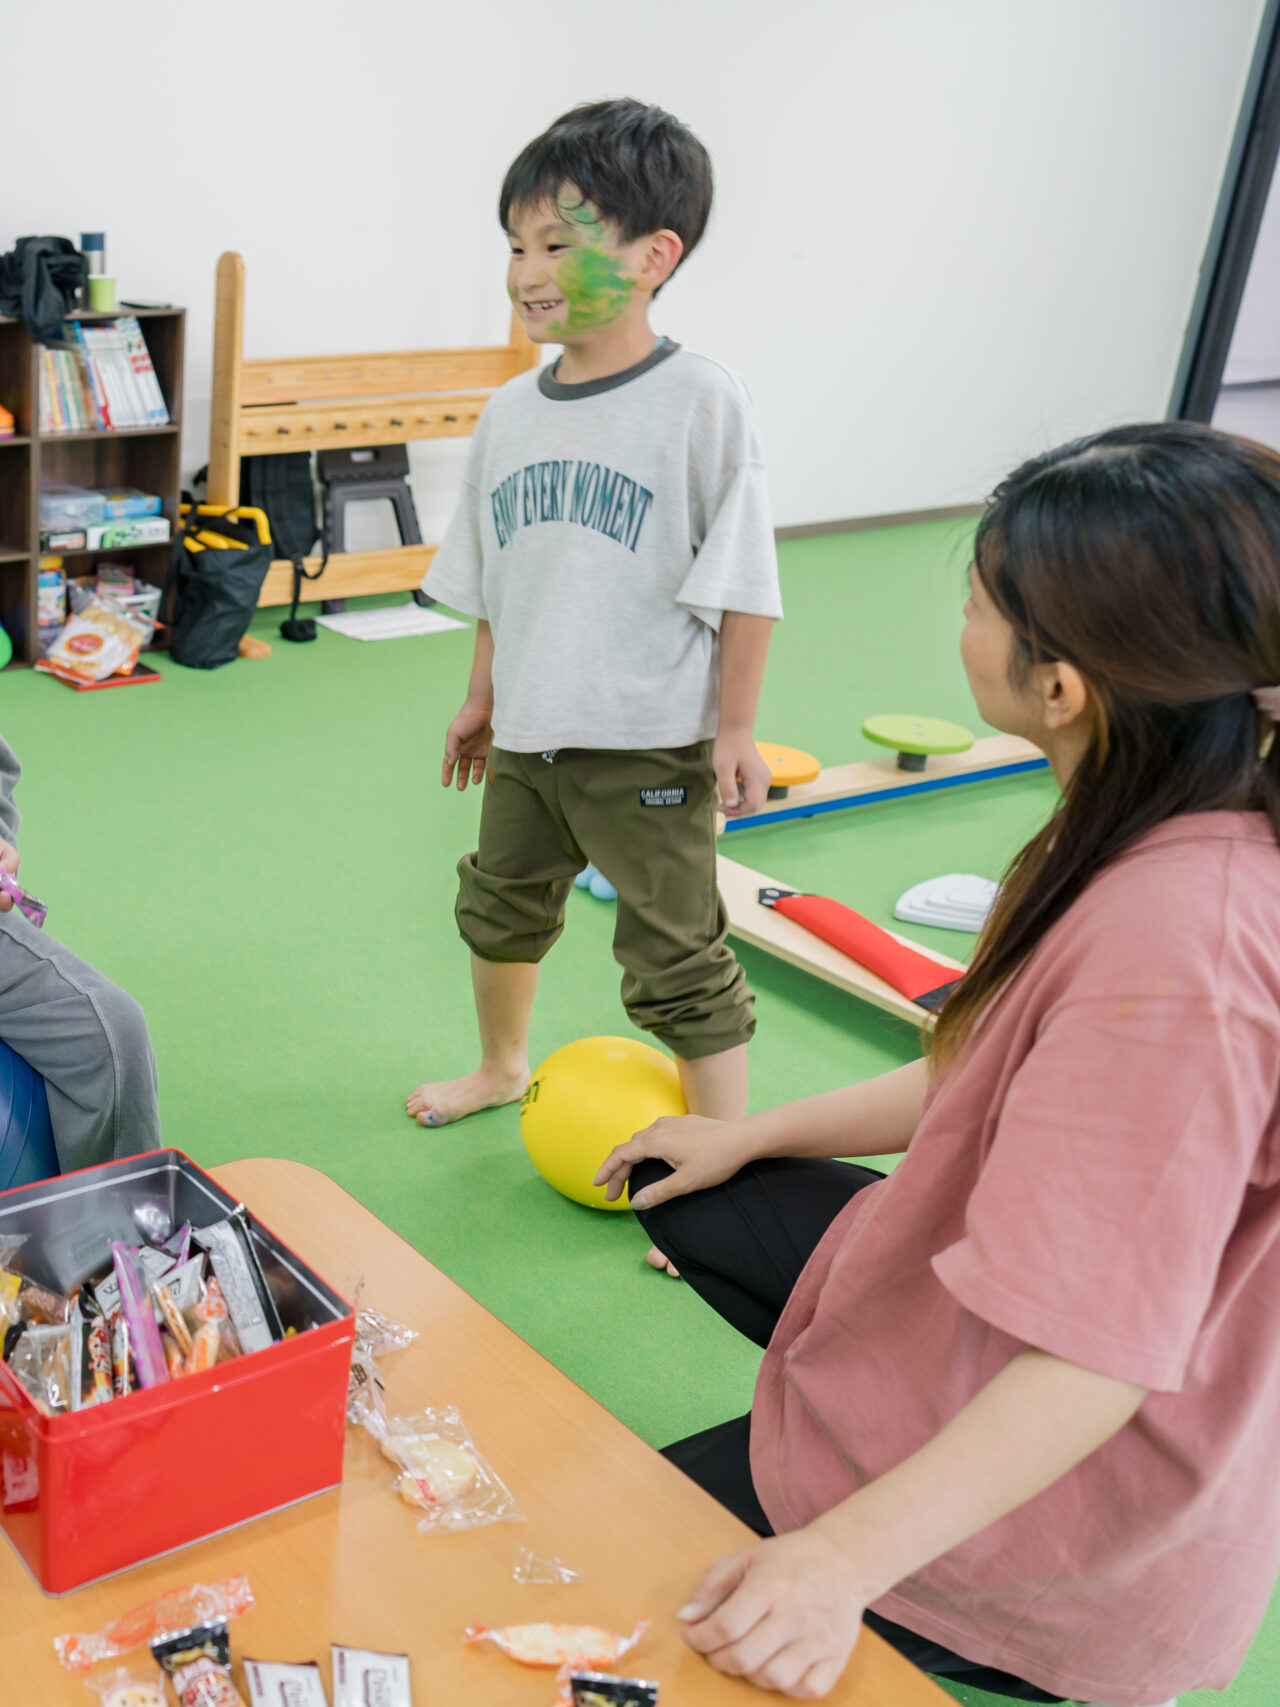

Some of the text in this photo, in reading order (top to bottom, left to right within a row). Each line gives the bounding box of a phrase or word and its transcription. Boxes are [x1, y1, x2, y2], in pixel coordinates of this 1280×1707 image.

[523, 460, 573, 526] EVERY
[569, 460, 653, 553] MOMENT
[641, 786, 685, 800] CALIFORNIA
